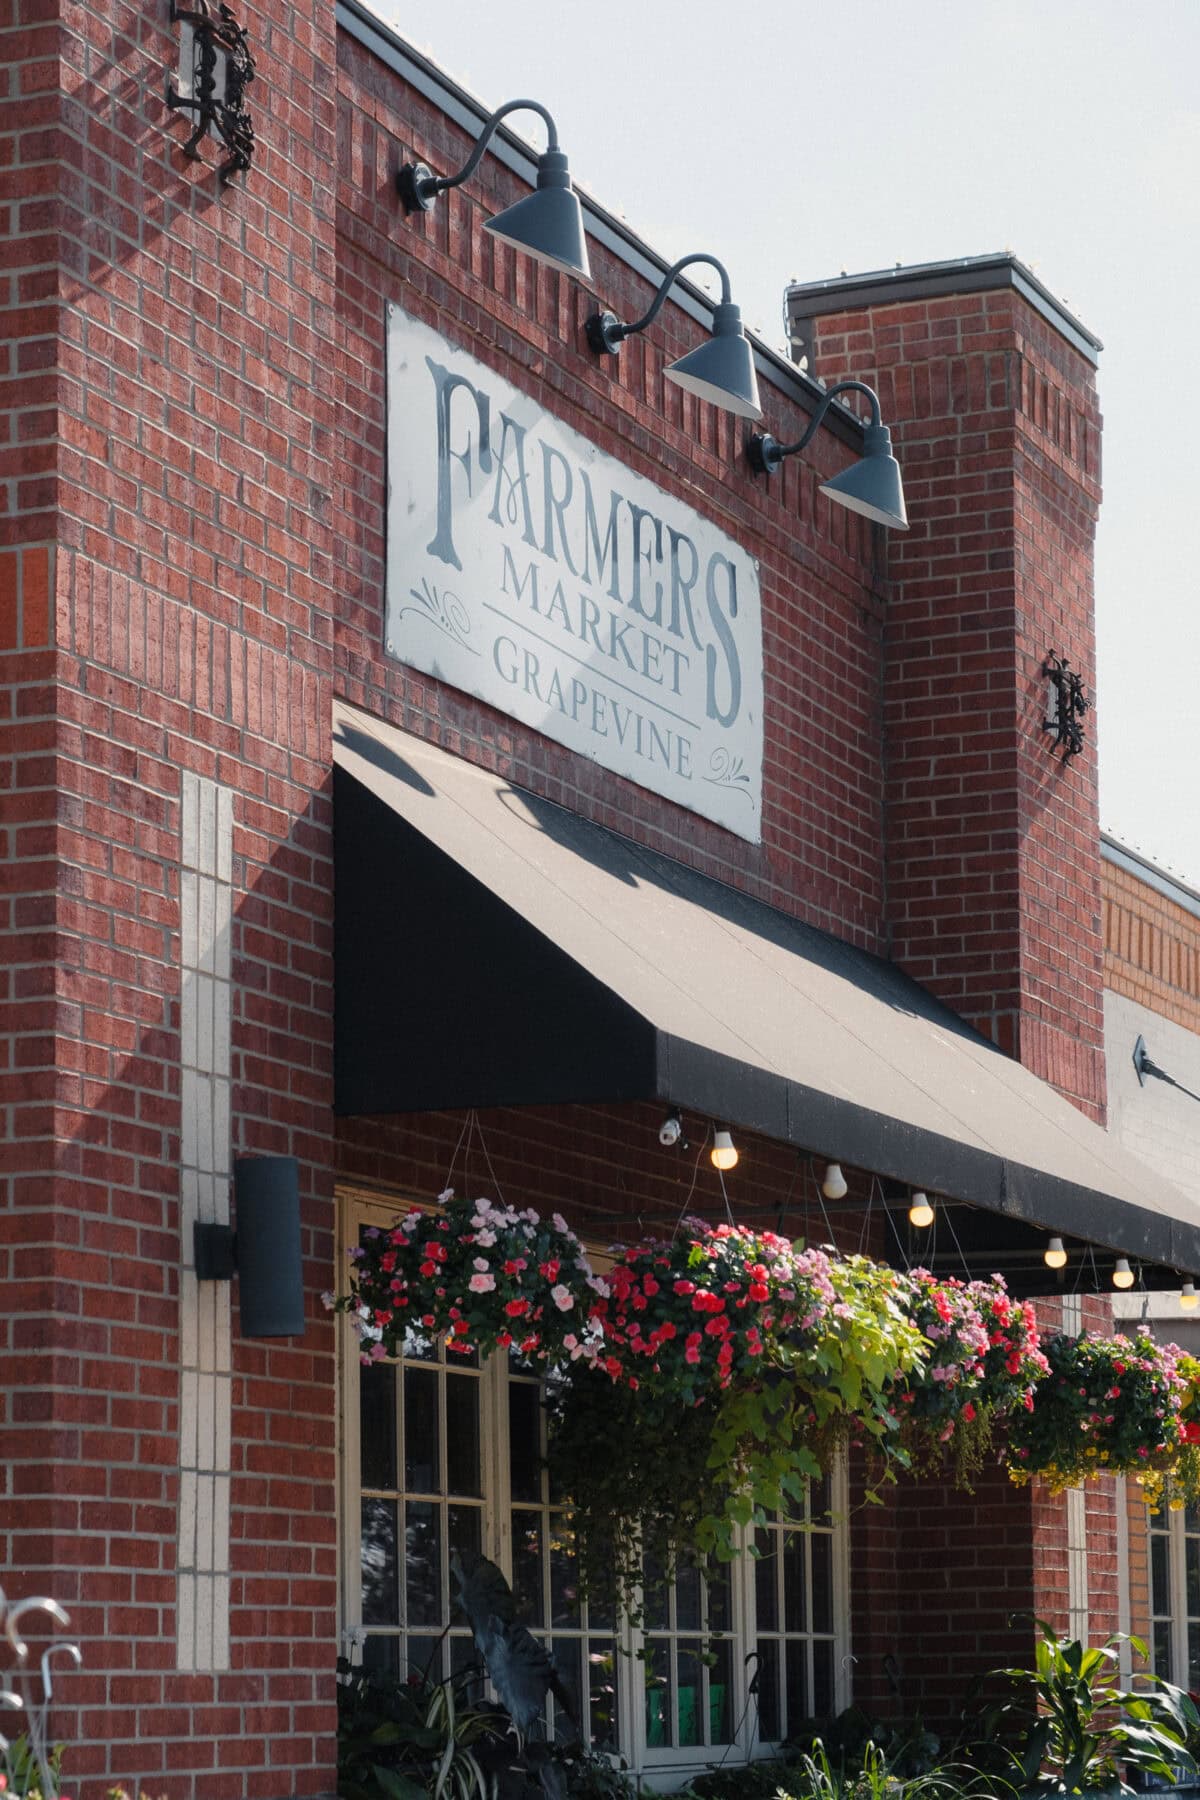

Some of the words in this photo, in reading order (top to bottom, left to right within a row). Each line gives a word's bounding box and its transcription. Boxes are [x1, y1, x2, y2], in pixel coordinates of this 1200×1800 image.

[425, 355, 742, 728] FARMERS
[501, 543, 690, 697] MARKET
[493, 635, 693, 780] GRAPEVINE
